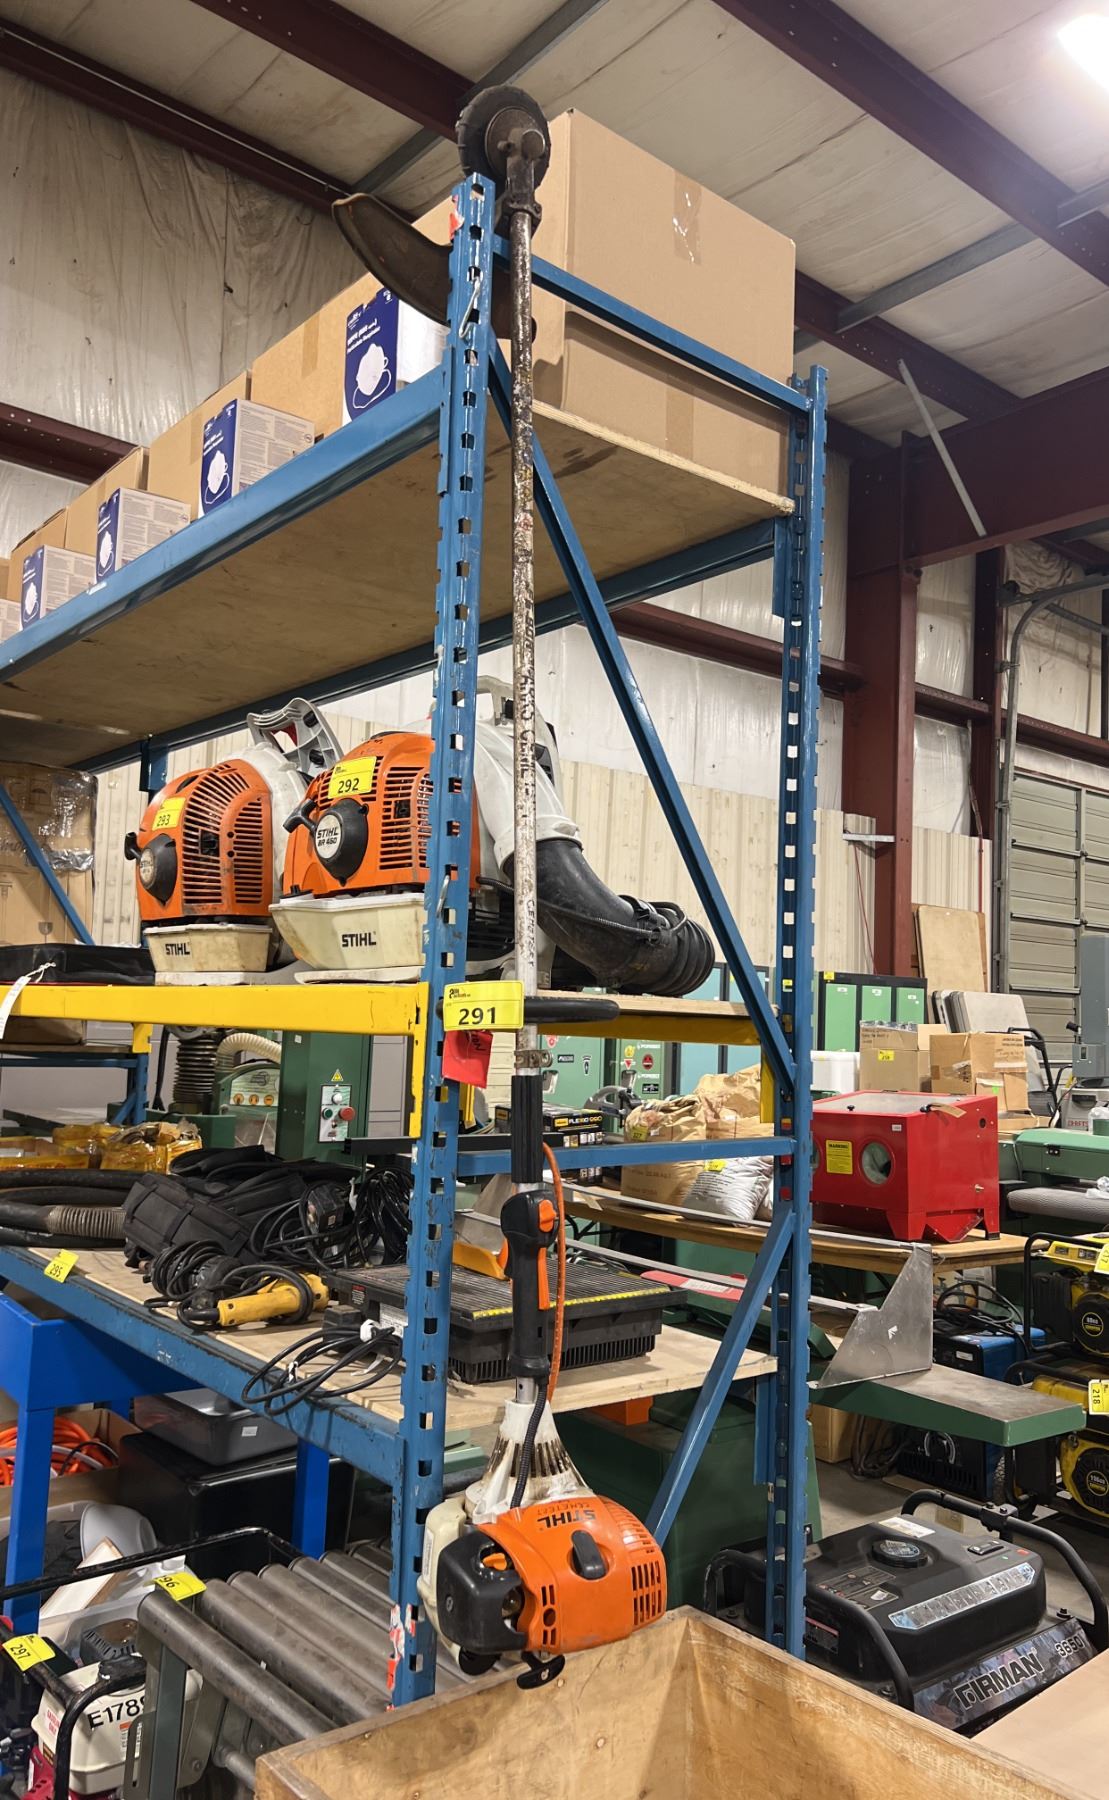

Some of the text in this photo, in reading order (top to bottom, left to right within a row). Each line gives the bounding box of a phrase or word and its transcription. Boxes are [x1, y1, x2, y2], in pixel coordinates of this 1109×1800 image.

[337, 778, 360, 794] 292
[156, 814, 171, 827] 293
[316, 826, 339, 839] STIHL
[342, 932, 376, 947] STIHL
[165, 943, 190, 955] STIHL
[458, 1007, 496, 1026] 291
[50, 1263, 63, 1277] 295
[1092, 1389, 1101, 1404] 218
[537, 1509, 596, 1528] STIHL
[10, 1643, 31, 1660] 297
[1055, 1633, 1085, 1658] 3650
[953, 1652, 1046, 1710] FIRMAN
